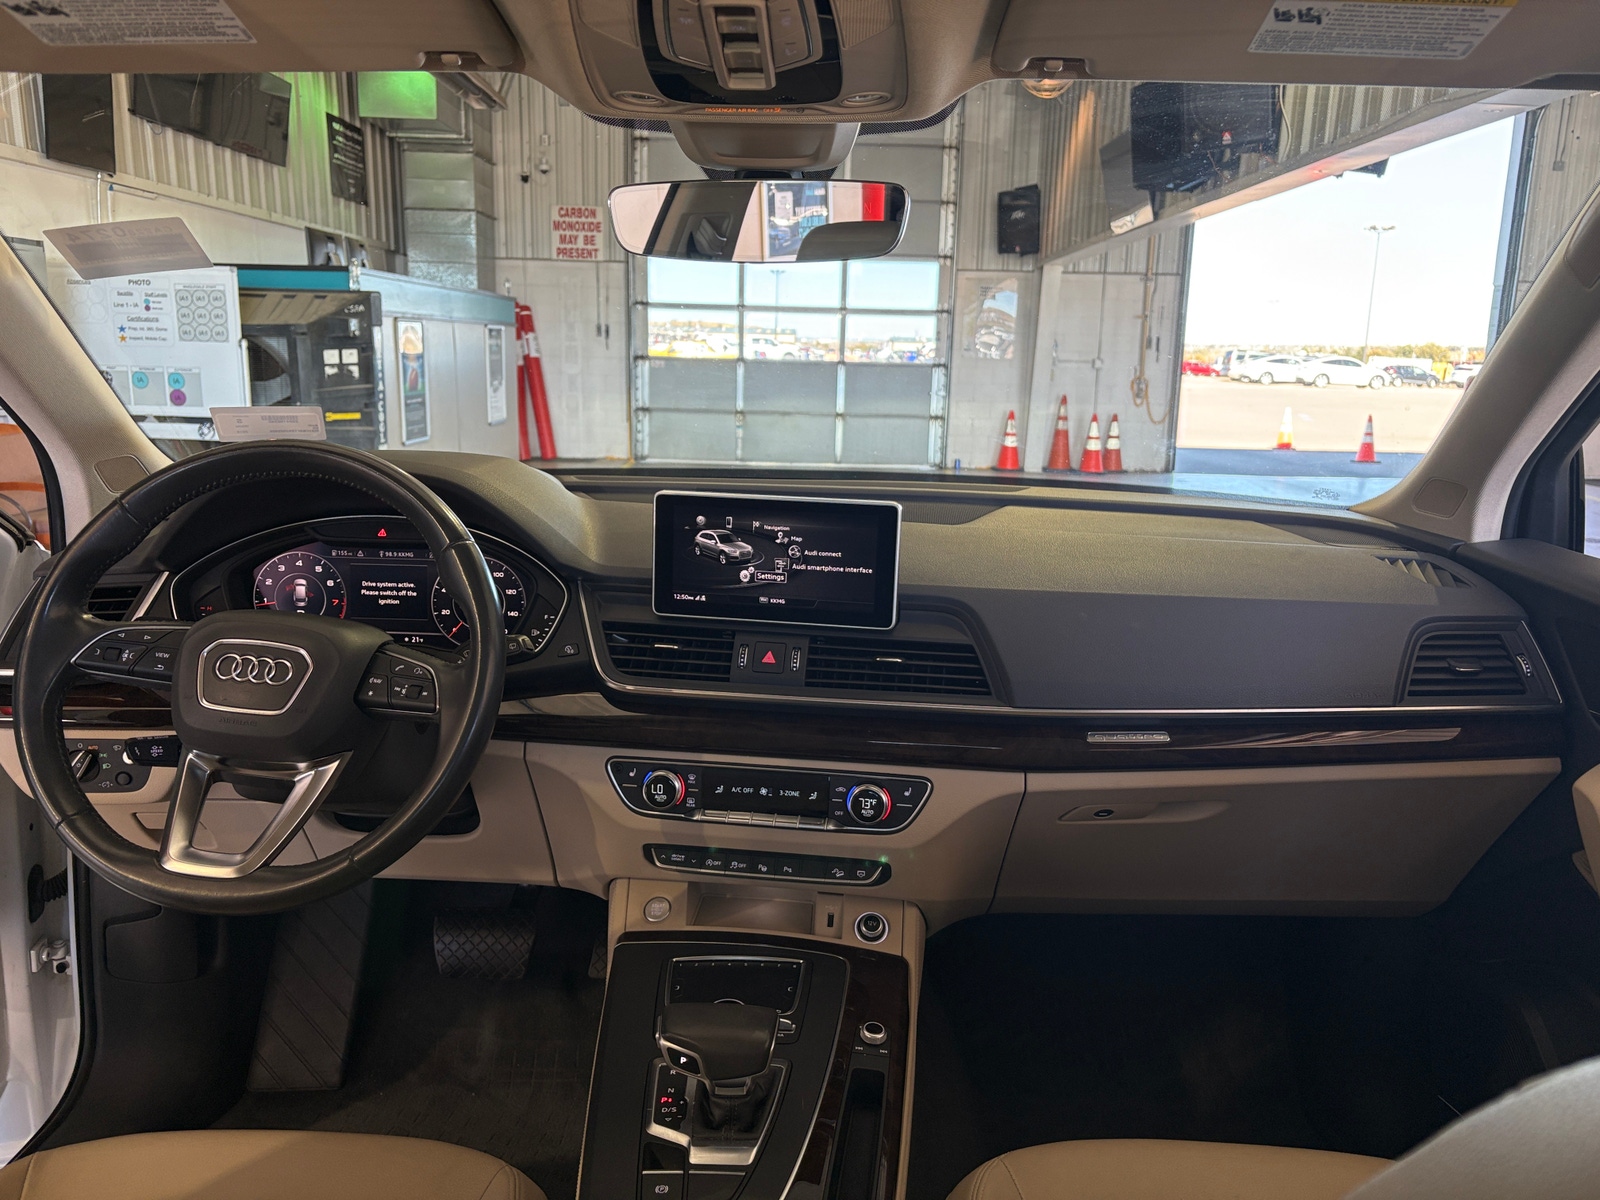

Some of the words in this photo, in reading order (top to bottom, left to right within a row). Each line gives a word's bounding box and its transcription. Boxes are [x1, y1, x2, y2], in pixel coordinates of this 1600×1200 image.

[558, 206, 597, 219] CARBON
[552, 220, 603, 233] MONOXIDE
[559, 233, 579, 245] MAY
[583, 235, 597, 246] BE
[556, 247, 599, 259] PRESENT
[763, 524, 790, 533] Navigation
[790, 535, 803, 544] Map
[803, 549, 818, 558] Audi
[818, 550, 842, 558] connect
[278, 564, 286, 572] 3
[315, 565, 323, 573] 5
[792, 562, 806, 571] Audi
[806, 564, 844, 574] smartphone
[844, 566, 873, 574] interface
[493, 571, 505, 579] 100
[757, 572, 785, 582] Settings
[265, 578, 273, 586] 2
[326, 579, 335, 587] 6
[361, 580, 376, 588] Drive
[377, 581, 398, 589] system
[379, 589, 399, 597] switch
[673, 593, 689, 601] 12:50
[378, 598, 400, 606] ignition
[1094, 734, 1164, 742] quattro
[651, 784, 664, 795] LO
[731, 786, 742, 794] A/C
[743, 787, 755, 795] OFF
[779, 789, 801, 798] 3-ZONE
[858, 797, 878, 809] 73°F
[860, 809, 875, 817] AUTO
[680, 1056, 688, 1064] P
